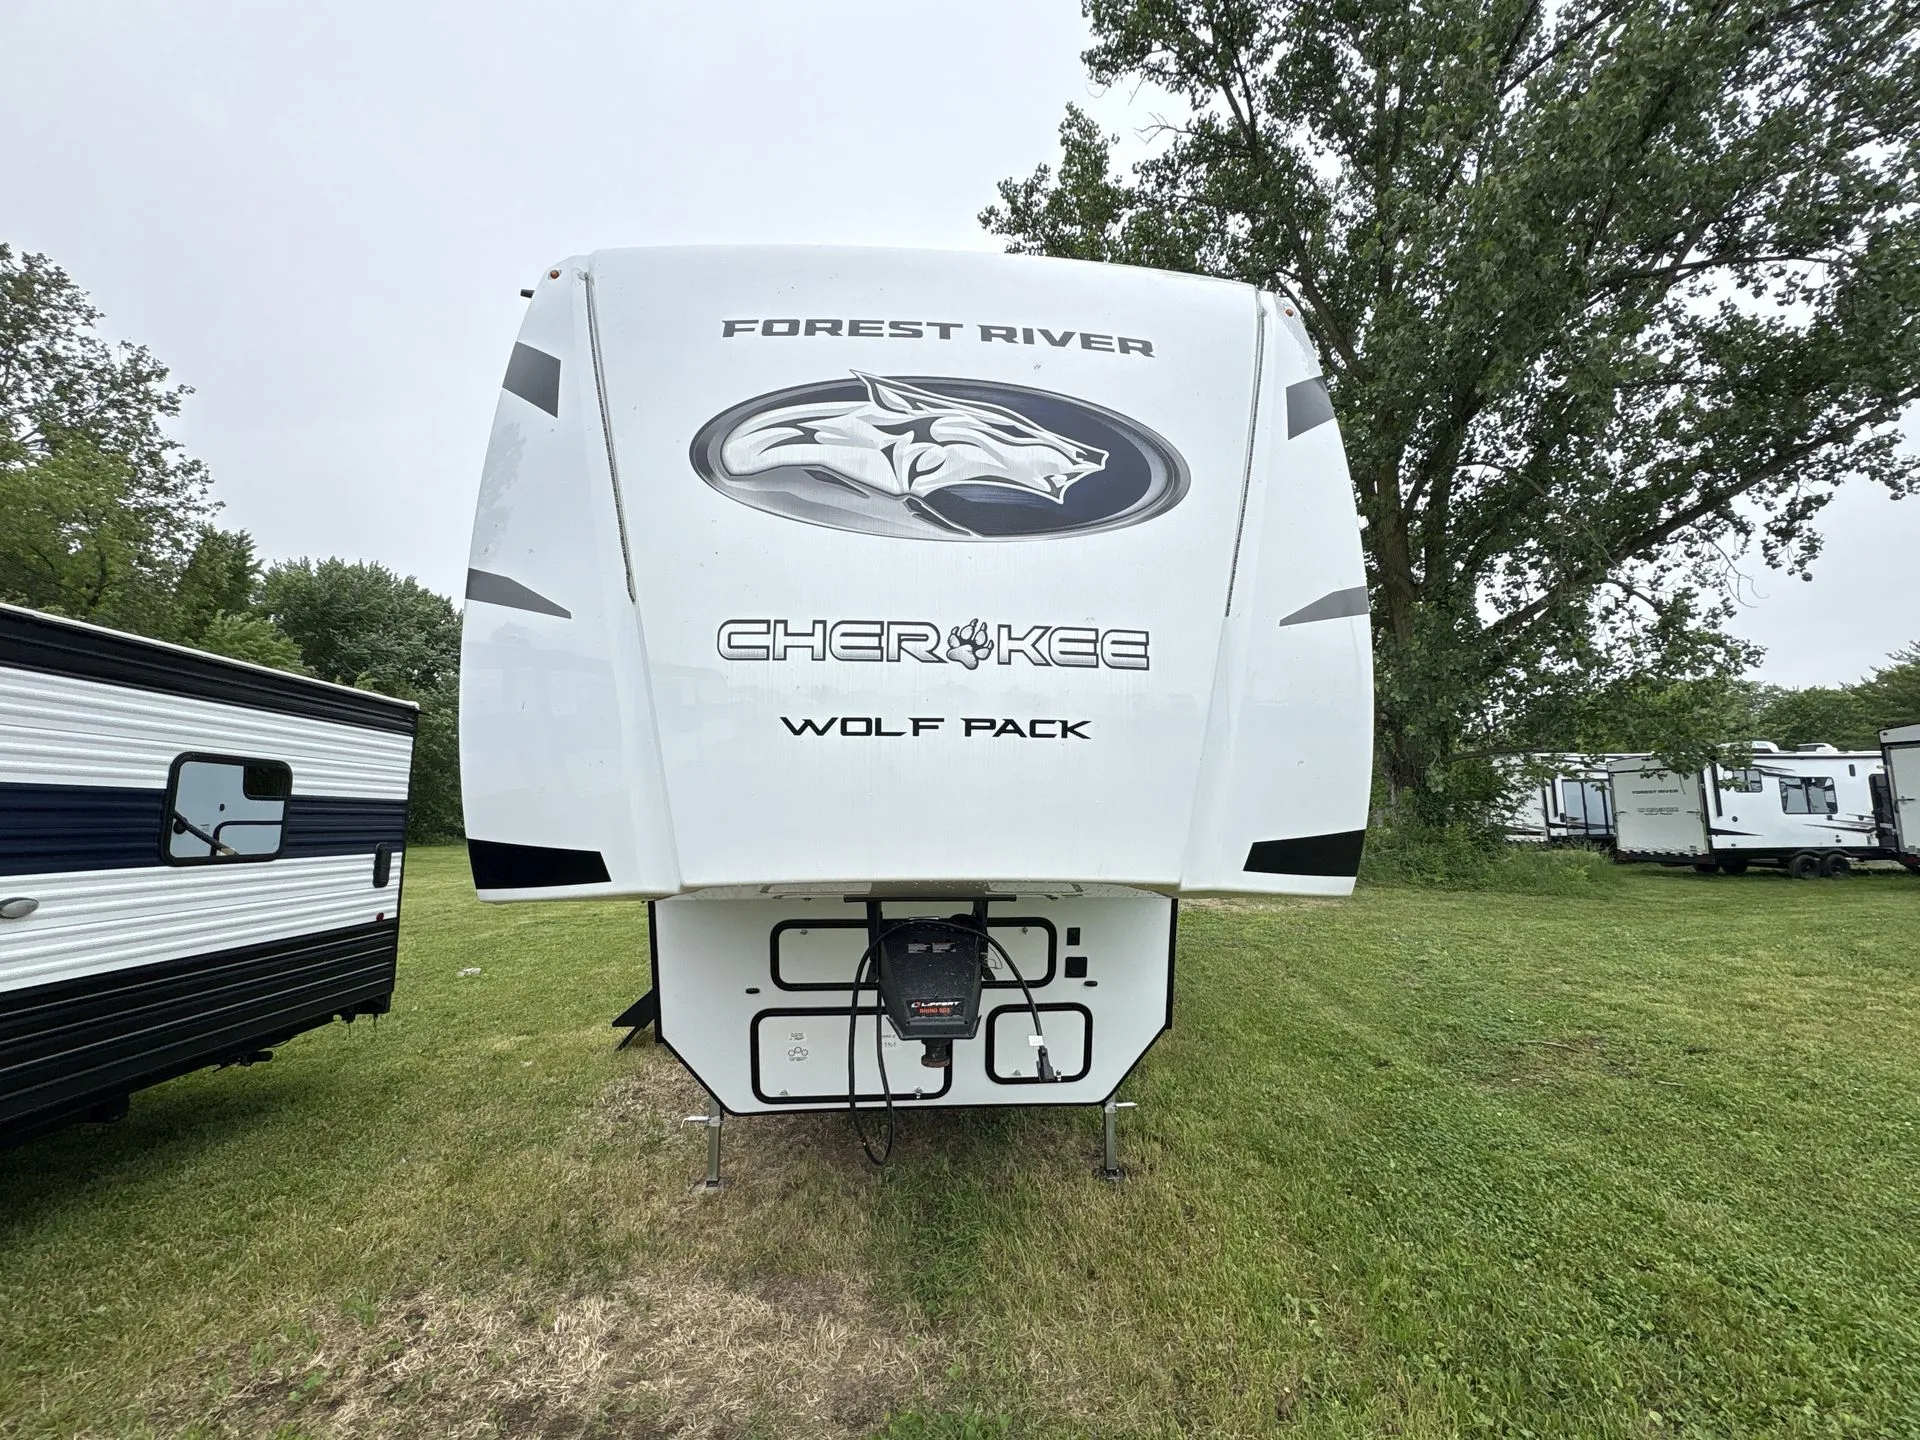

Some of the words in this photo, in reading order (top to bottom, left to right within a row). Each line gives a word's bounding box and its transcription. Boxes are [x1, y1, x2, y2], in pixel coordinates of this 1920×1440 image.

[722, 319, 963, 340] FOREST
[977, 324, 1155, 358] RIVER
[780, 716, 945, 737] WOLF
[960, 717, 1092, 740] PACK
